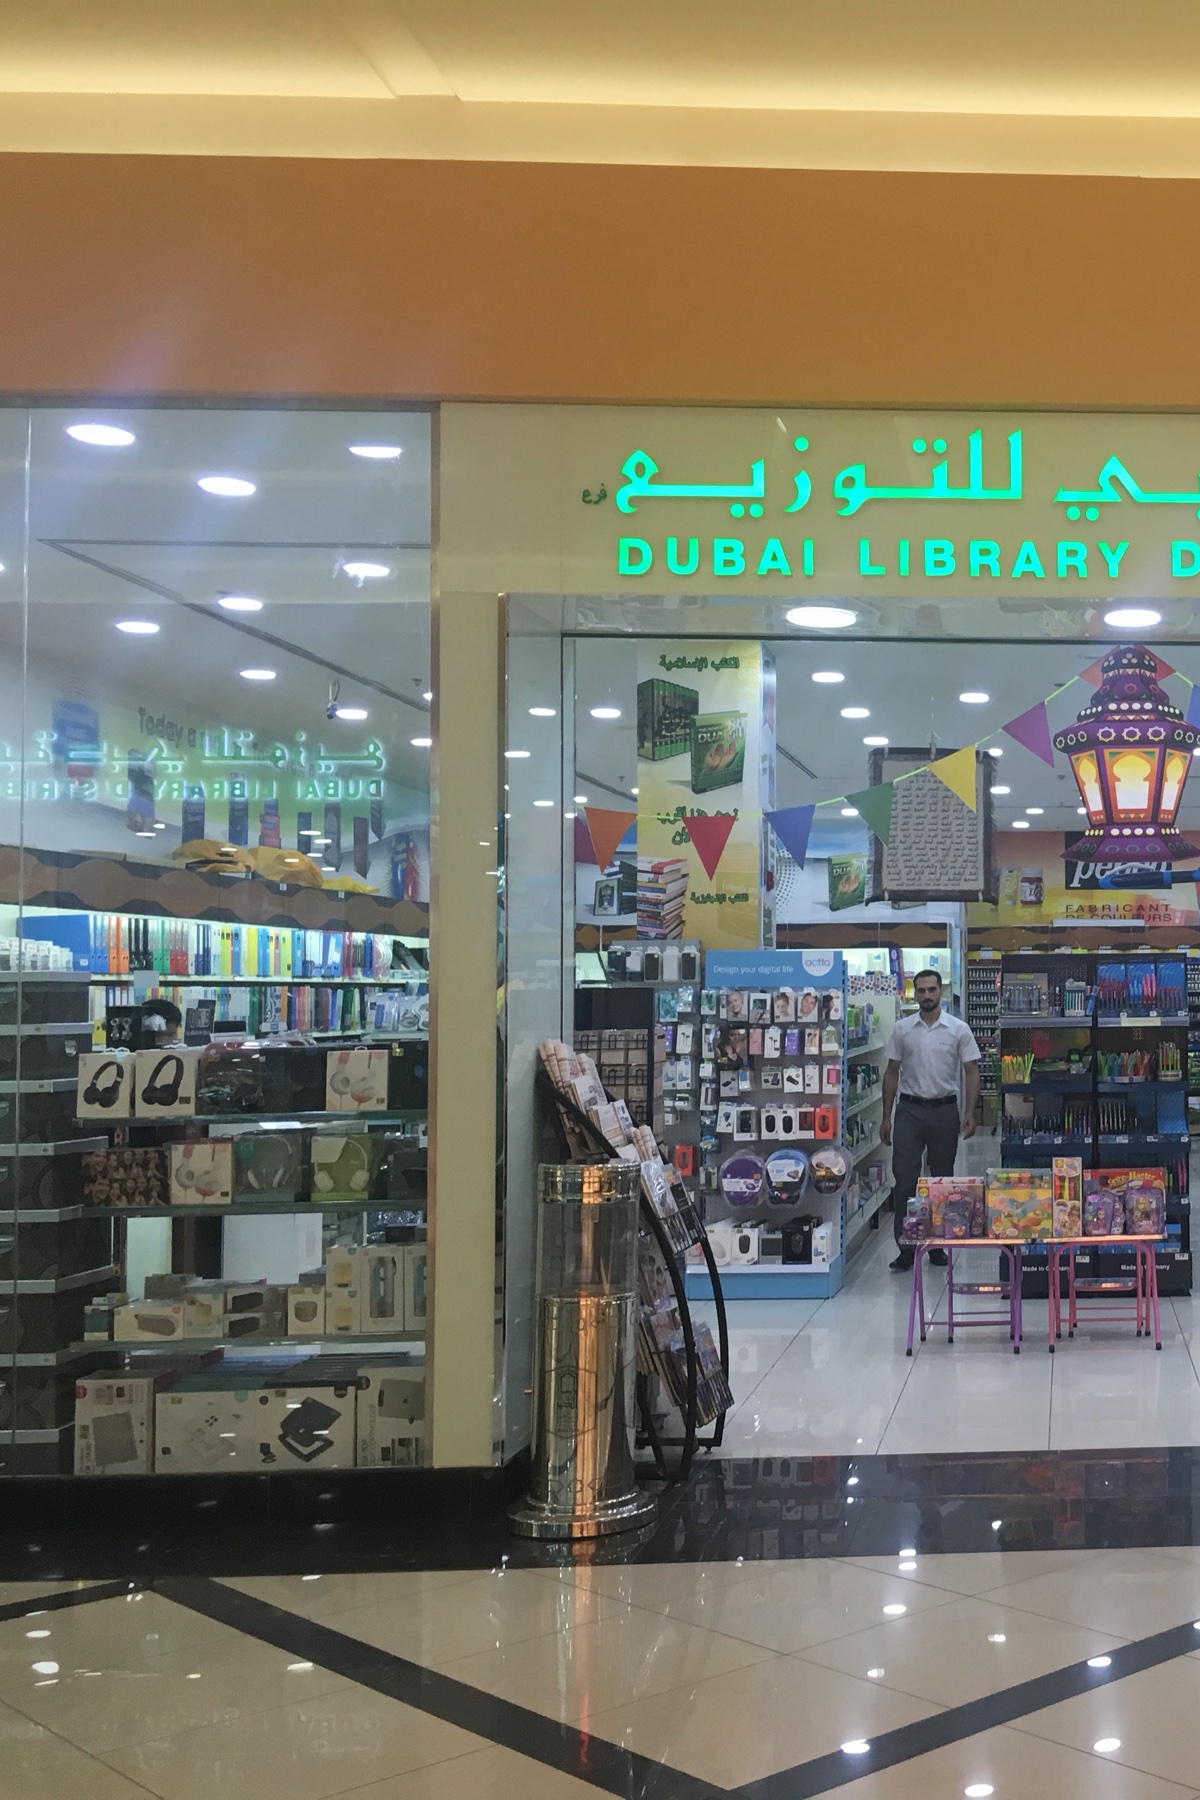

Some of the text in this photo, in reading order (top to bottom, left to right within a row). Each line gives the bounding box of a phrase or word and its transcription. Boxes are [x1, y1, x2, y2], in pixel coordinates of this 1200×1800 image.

[614, 428, 1023, 519] للتوزيع
[617, 535, 815, 577] DUBAI
[858, 537, 1130, 579] LIBRARY
[1065, 903, 1172, 913] FABRICANT
[804, 958, 831, 968] actto
[713, 965, 794, 975] Design your digital life
